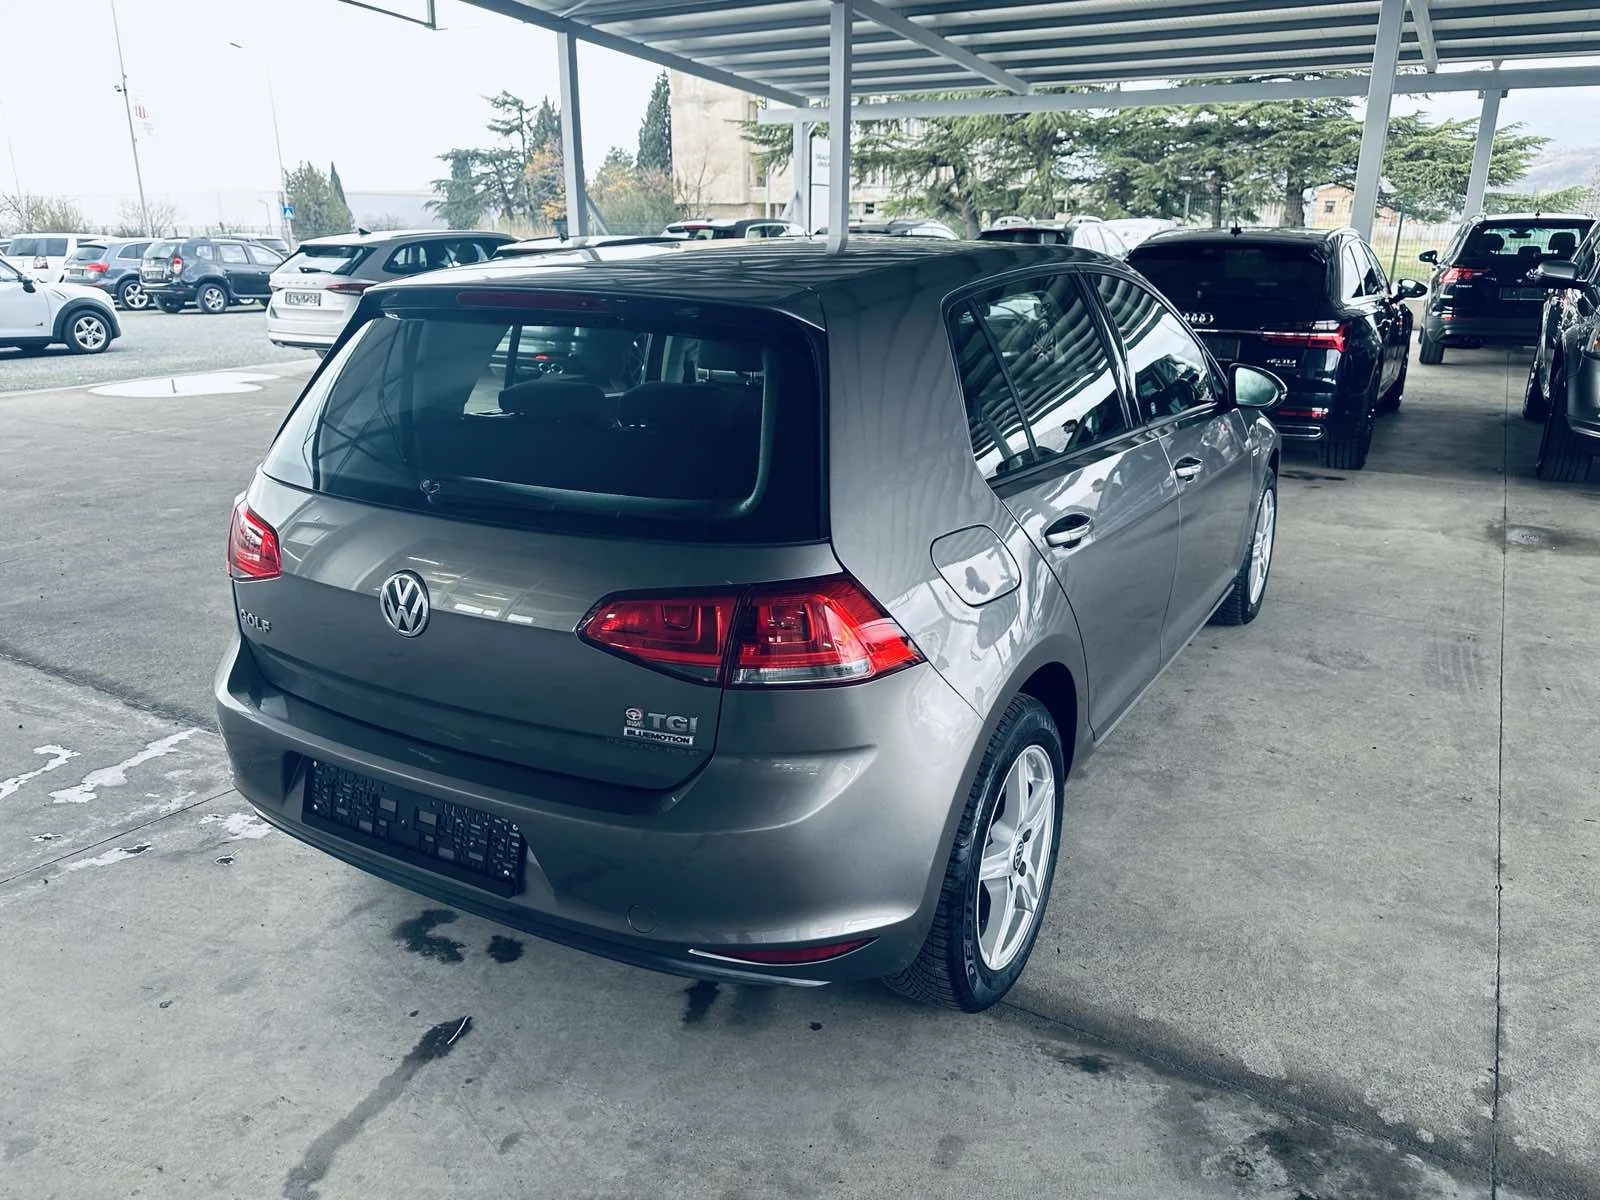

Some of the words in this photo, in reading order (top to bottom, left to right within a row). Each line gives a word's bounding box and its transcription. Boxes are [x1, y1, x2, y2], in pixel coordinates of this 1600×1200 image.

[380, 573, 429, 636] VW
[240, 608, 271, 632] GOLF
[647, 712, 697, 733] TGI
[627, 730, 690, 744] BLUEMOTION
